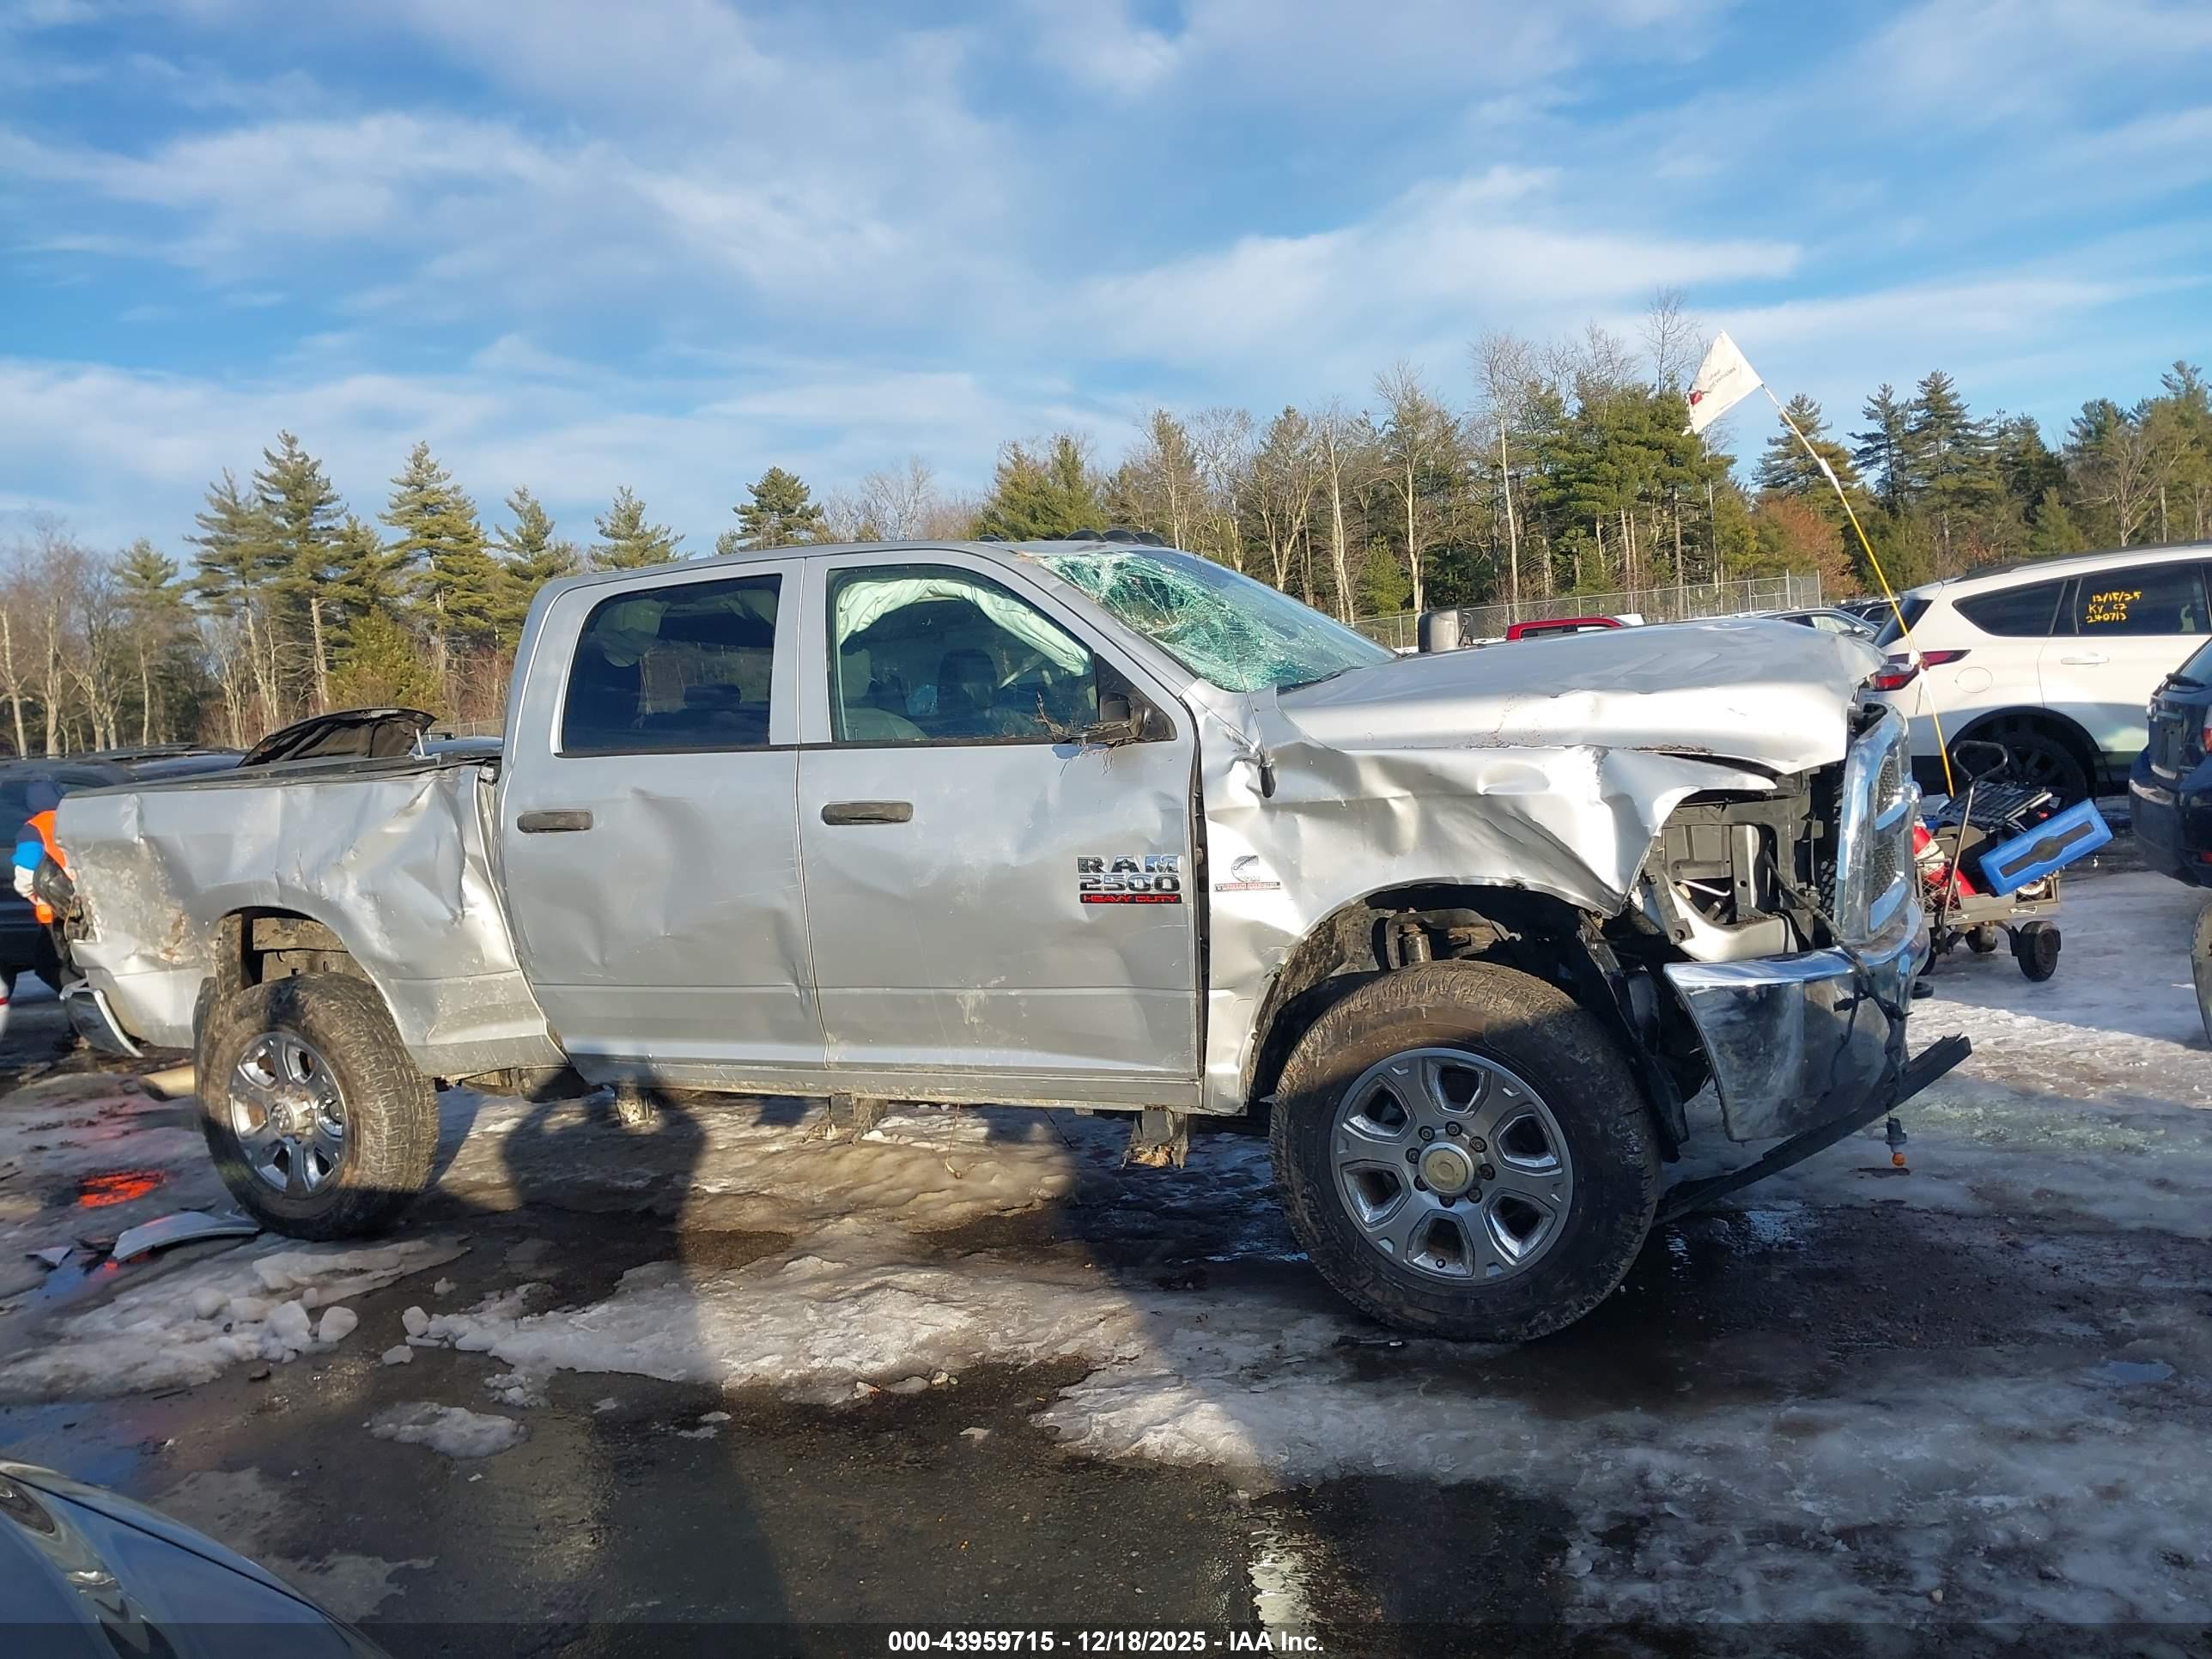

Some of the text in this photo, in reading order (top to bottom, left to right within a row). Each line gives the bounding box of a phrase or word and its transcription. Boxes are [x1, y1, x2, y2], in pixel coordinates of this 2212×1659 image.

[1077, 855, 1181, 873] RAM
[1079, 874, 1181, 893] 2500
[1084, 894, 1178, 902] HEAVY DUTY
